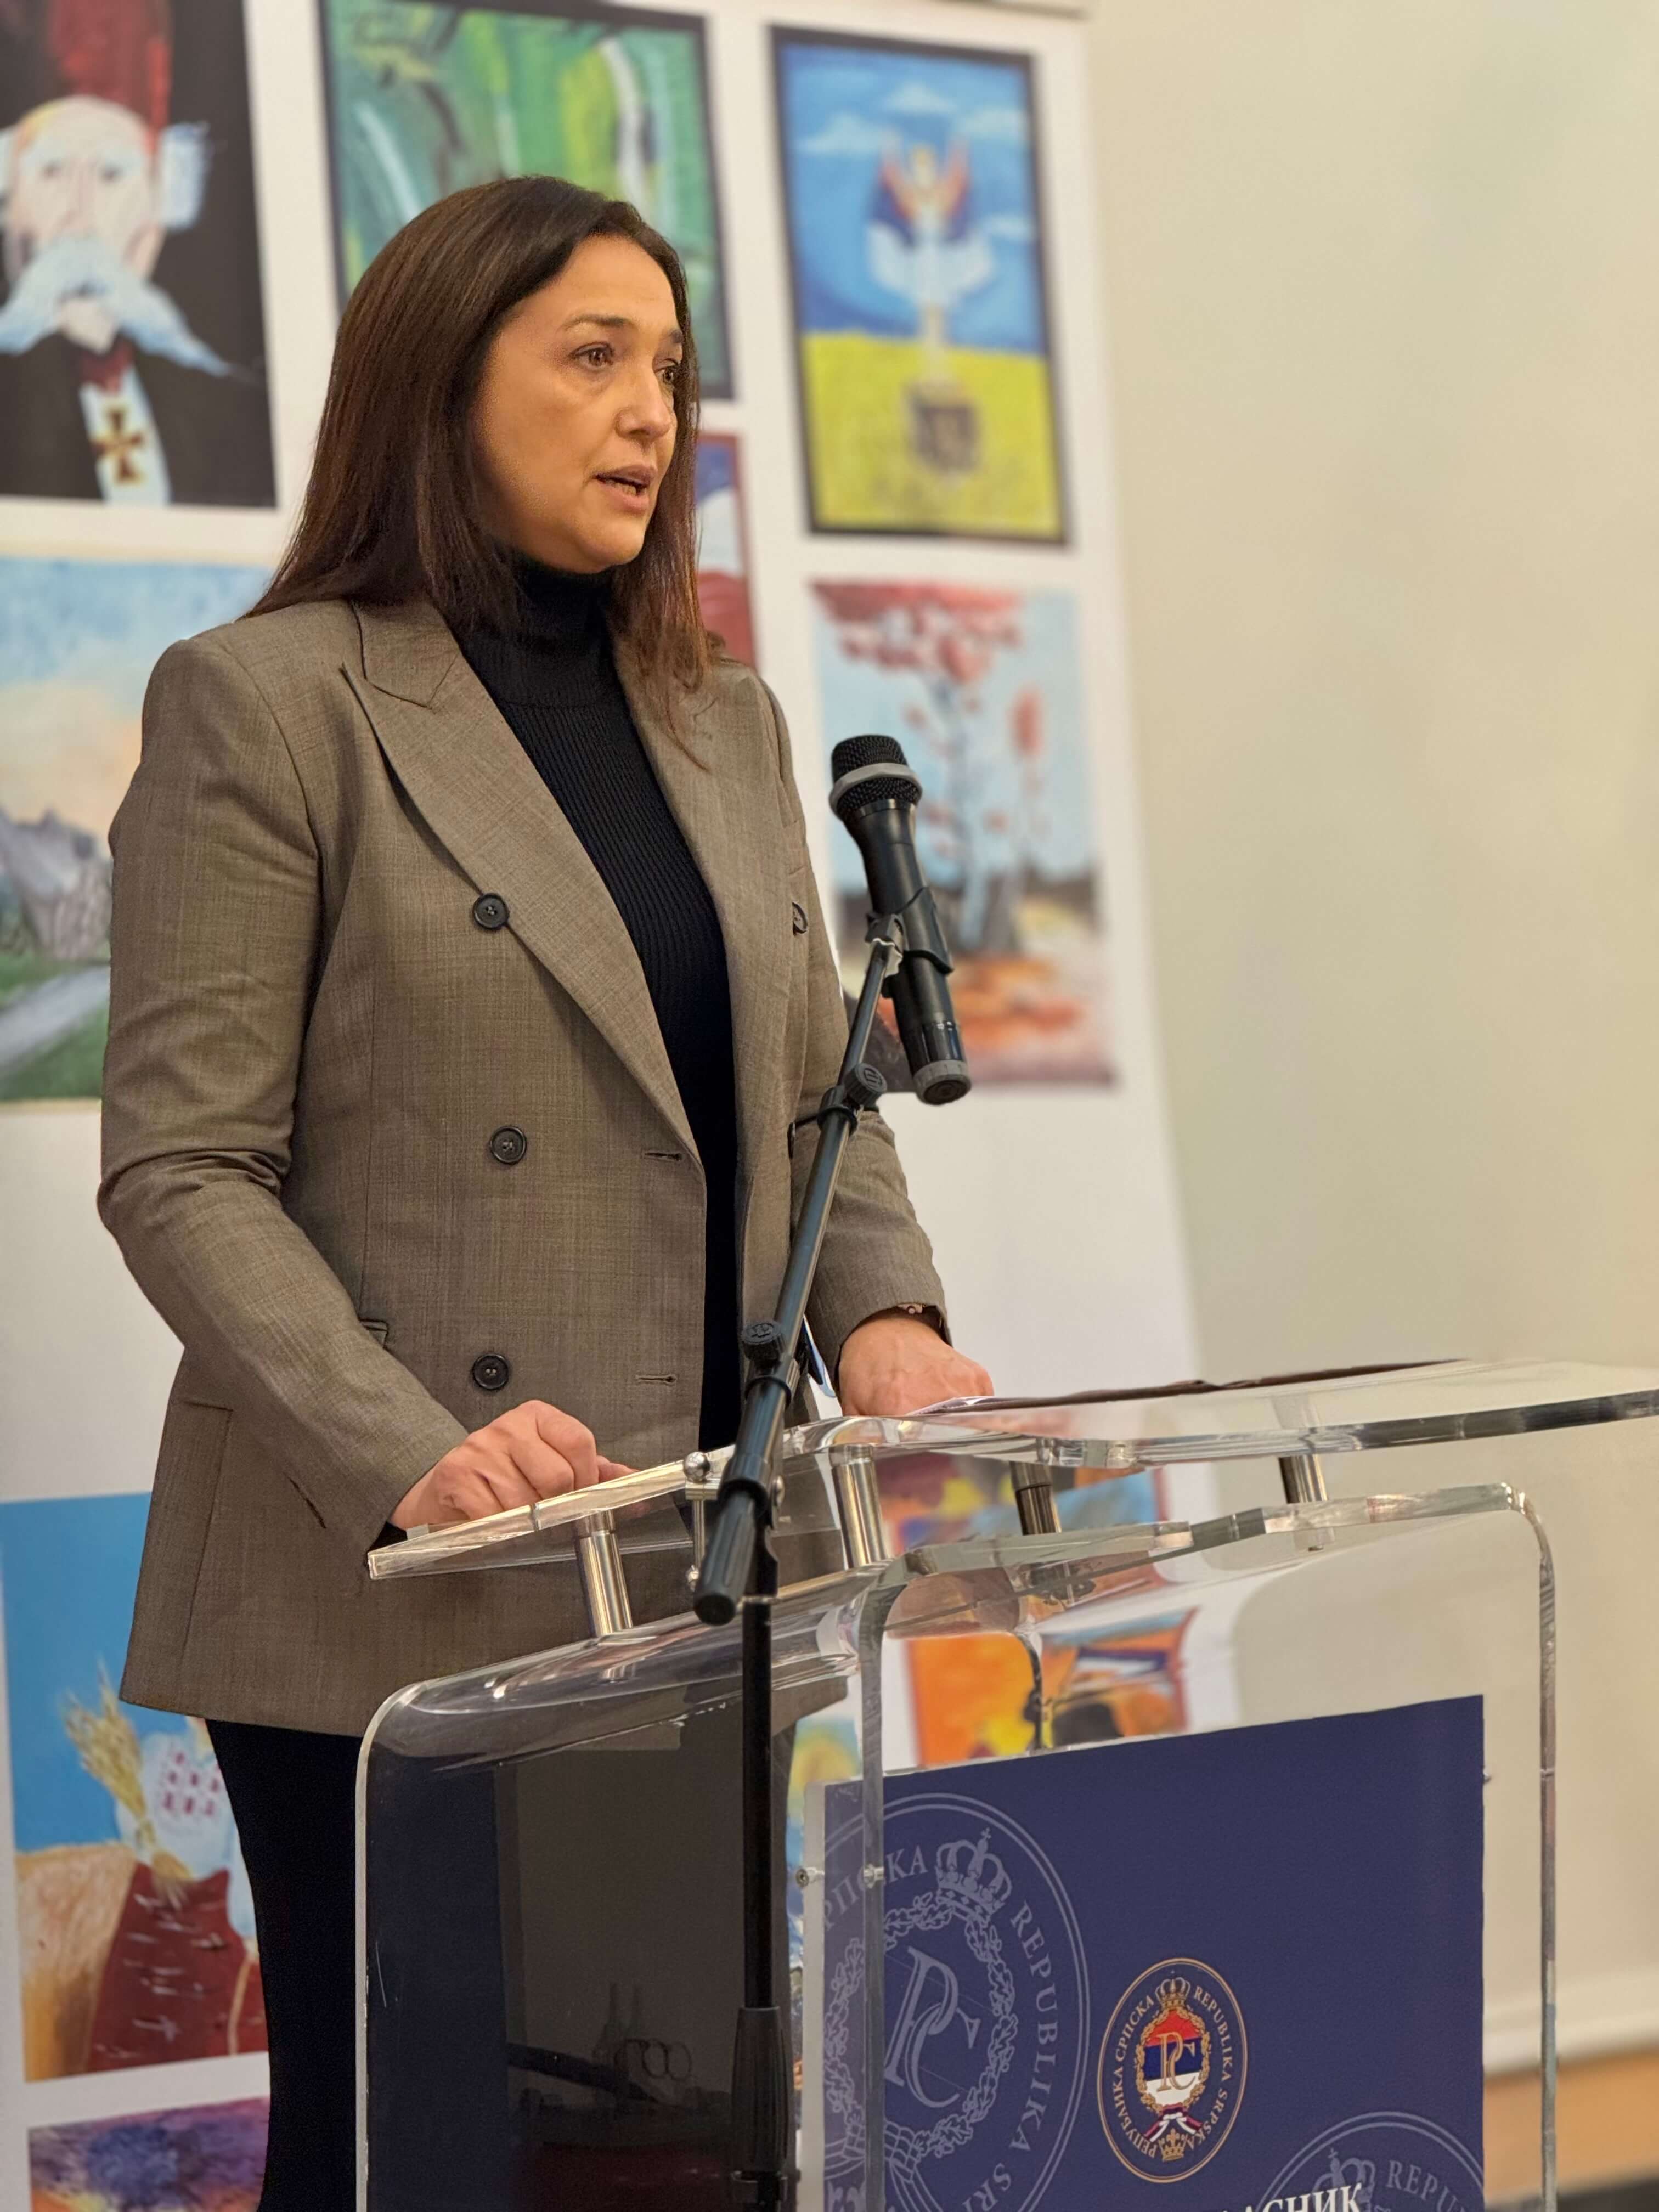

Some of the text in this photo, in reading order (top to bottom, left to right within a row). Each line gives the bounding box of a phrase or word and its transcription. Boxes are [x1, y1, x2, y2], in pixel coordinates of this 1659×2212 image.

[1009, 1900, 1058, 2152] REPUBLIKA
[1111, 1994, 1156, 2158] РЕПУБЛИКА СРПСКА
[1185, 1985, 1233, 2151] REPUBLIKA SRPSKA
[1385, 2159, 1466, 2212] REPU
